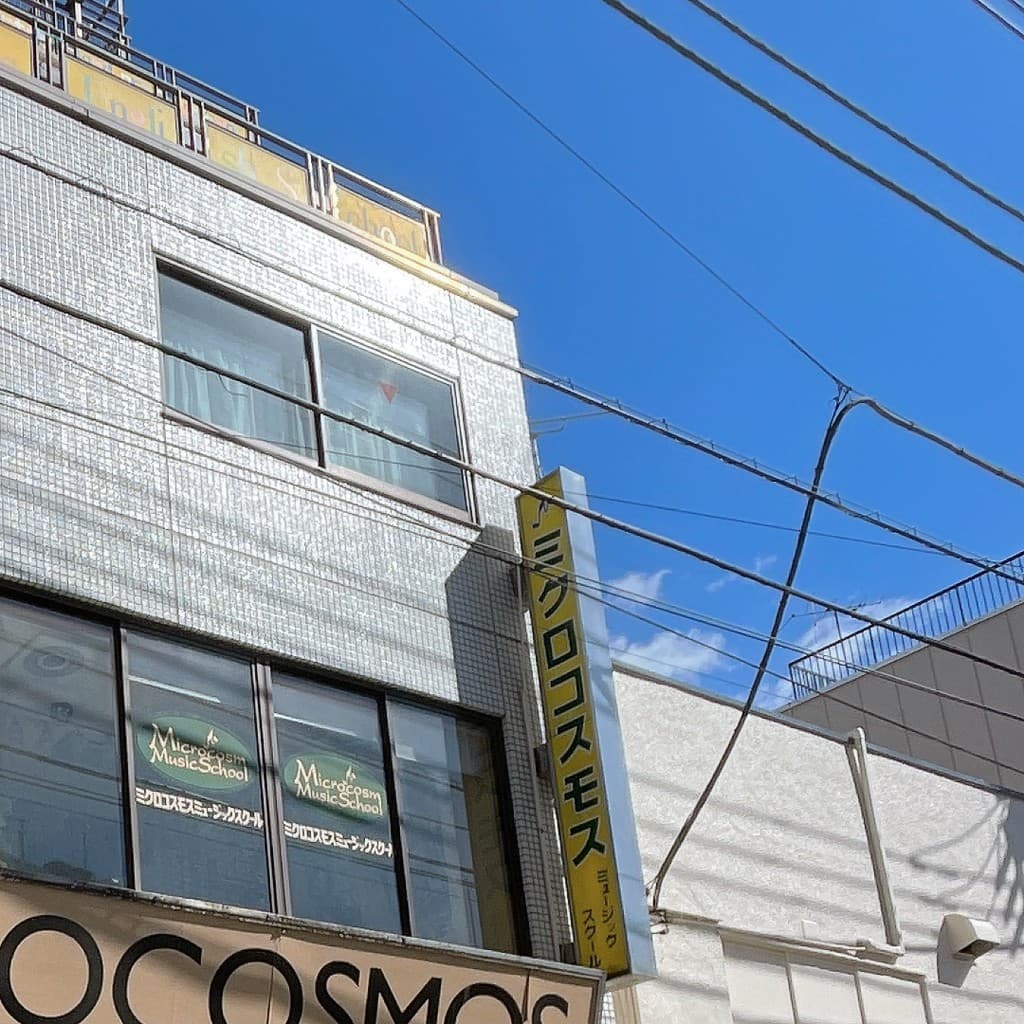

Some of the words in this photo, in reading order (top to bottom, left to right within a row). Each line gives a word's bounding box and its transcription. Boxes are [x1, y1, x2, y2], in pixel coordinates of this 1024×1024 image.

[533, 529, 606, 867] ミクロコスモス
[149, 723, 246, 765] Microcosm
[295, 759, 380, 801] Microcosm
[582, 908, 601, 968] スクール
[597, 869, 617, 949] ミュージック
